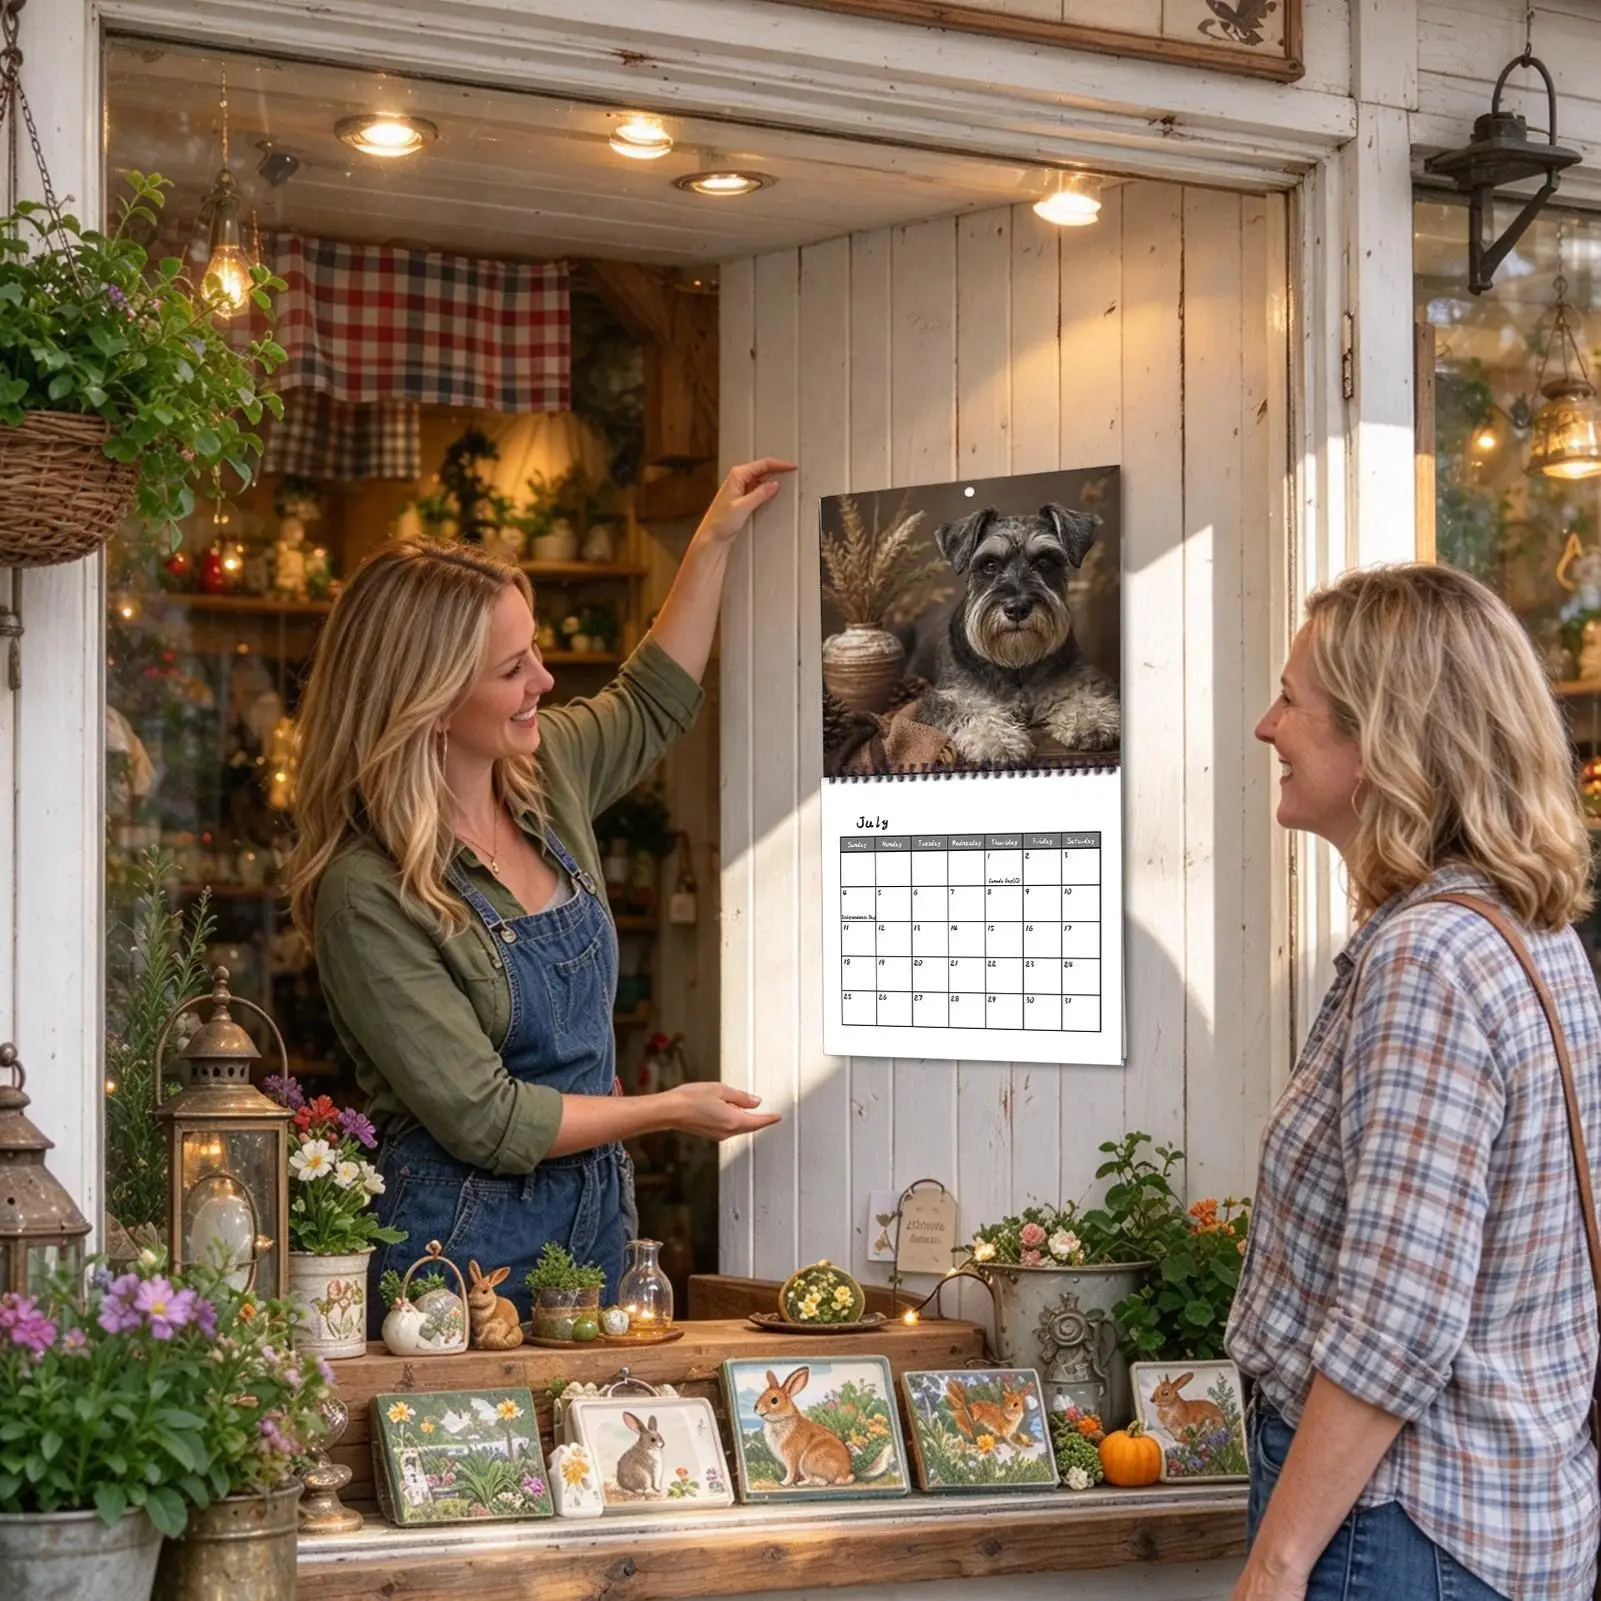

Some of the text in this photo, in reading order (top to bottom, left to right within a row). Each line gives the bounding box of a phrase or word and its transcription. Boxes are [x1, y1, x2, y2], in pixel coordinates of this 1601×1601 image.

[856, 816, 888, 830] July
[882, 840, 902, 848] Monday
[918, 840, 940, 848] Tuesday
[992, 838, 1018, 846] Thursday
[1032, 838, 1054, 846] Friday
[1066, 838, 1096, 846] Saturday
[1064, 888, 1072, 896] 10
